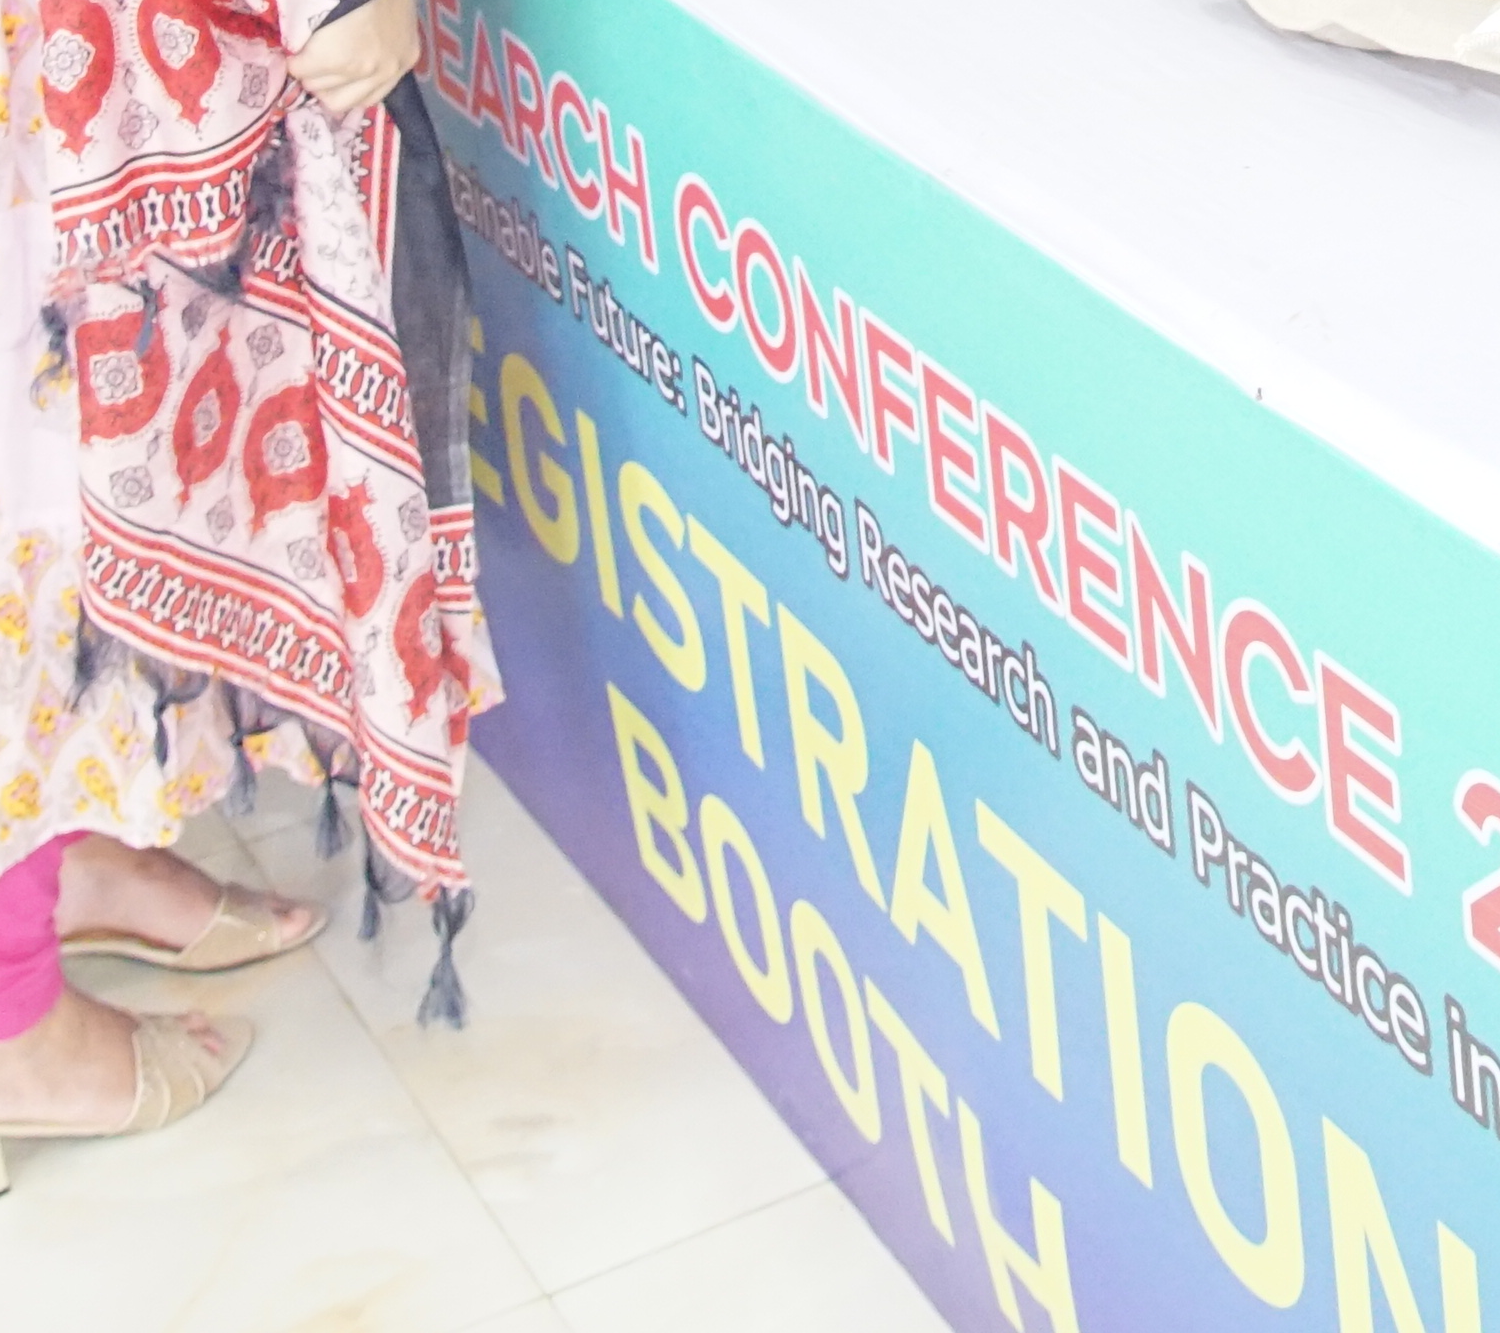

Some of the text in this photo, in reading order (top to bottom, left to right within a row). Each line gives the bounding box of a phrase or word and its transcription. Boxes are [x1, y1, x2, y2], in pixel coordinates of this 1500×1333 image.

[446, 150, 564, 306] tainable
[565, 241, 689, 416] Future:
[694, 371, 850, 579] Bridging
[856, 497, 1062, 757] Research
[1073, 696, 1175, 854] and
[1187, 783, 1434, 1085] Practice
[468, 315, 1481, 1333] GISTRATION
[676, 173, 1412, 896] CONFERENCE
[608, 683, 1082, 1333] BOOTH
